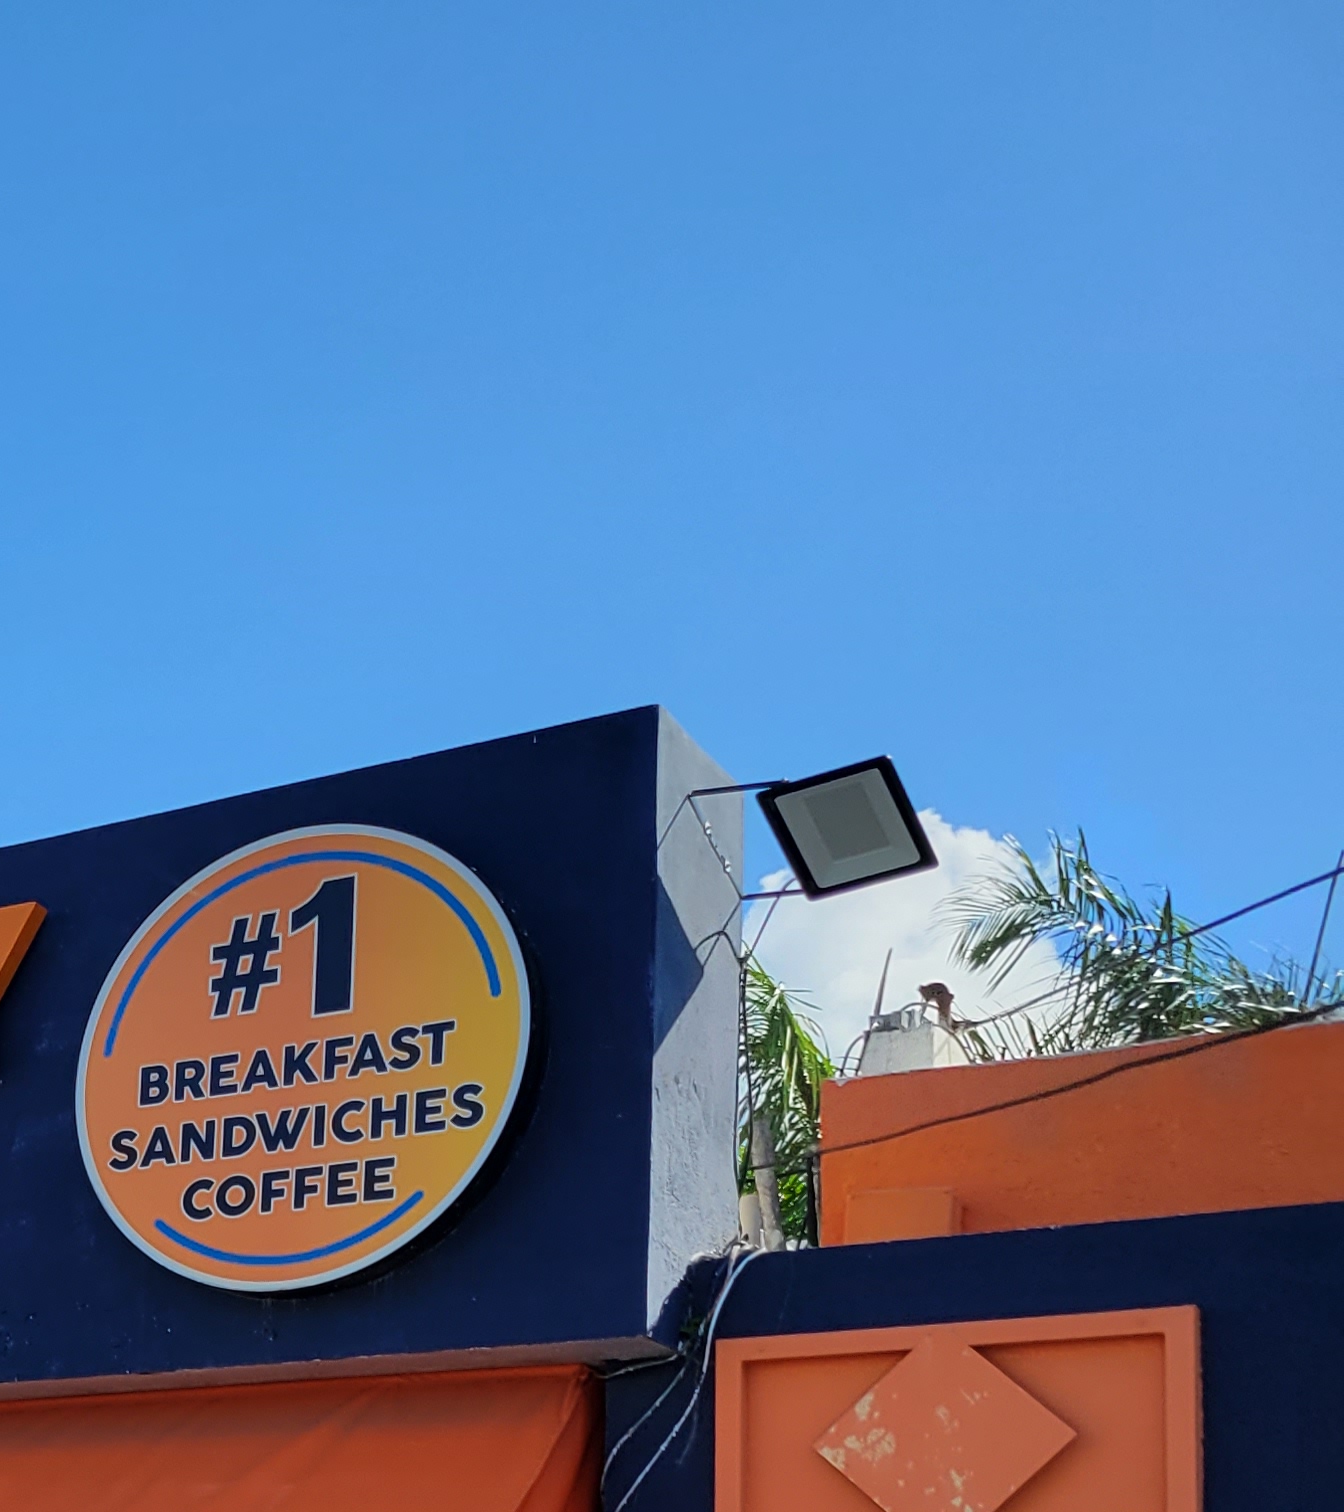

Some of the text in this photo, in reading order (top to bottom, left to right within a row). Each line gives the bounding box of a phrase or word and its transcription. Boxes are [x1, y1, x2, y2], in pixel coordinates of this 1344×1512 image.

[209, 873, 358, 1019] #1
[138, 1019, 456, 1108] BREAKFAST
[108, 1083, 485, 1171] SANDWICHES
[182, 1156, 397, 1222] COFFEE
